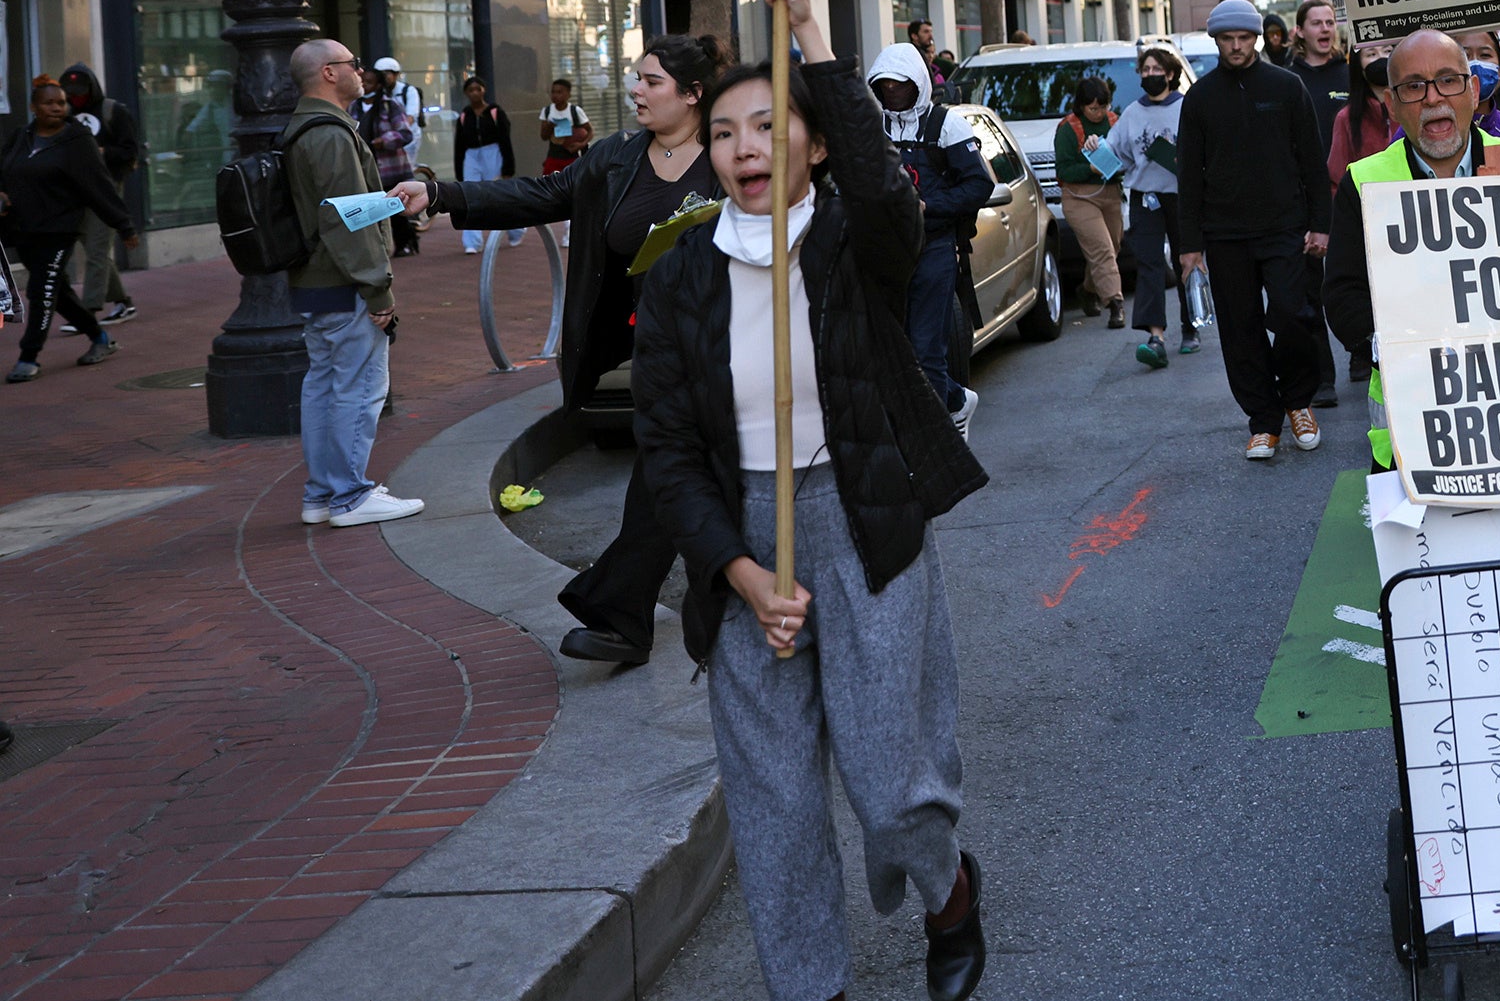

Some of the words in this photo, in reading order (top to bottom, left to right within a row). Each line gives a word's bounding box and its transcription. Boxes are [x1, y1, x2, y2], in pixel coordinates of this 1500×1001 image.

[1357, 20, 1384, 40] PSL
[1384, 18, 1407, 28] Party
[1409, 16, 1421, 24] for
[1422, 10, 1464, 22] Socialism
[1465, 7, 1482, 17] and
[1433, 473, 1484, 494] JUSTICE
